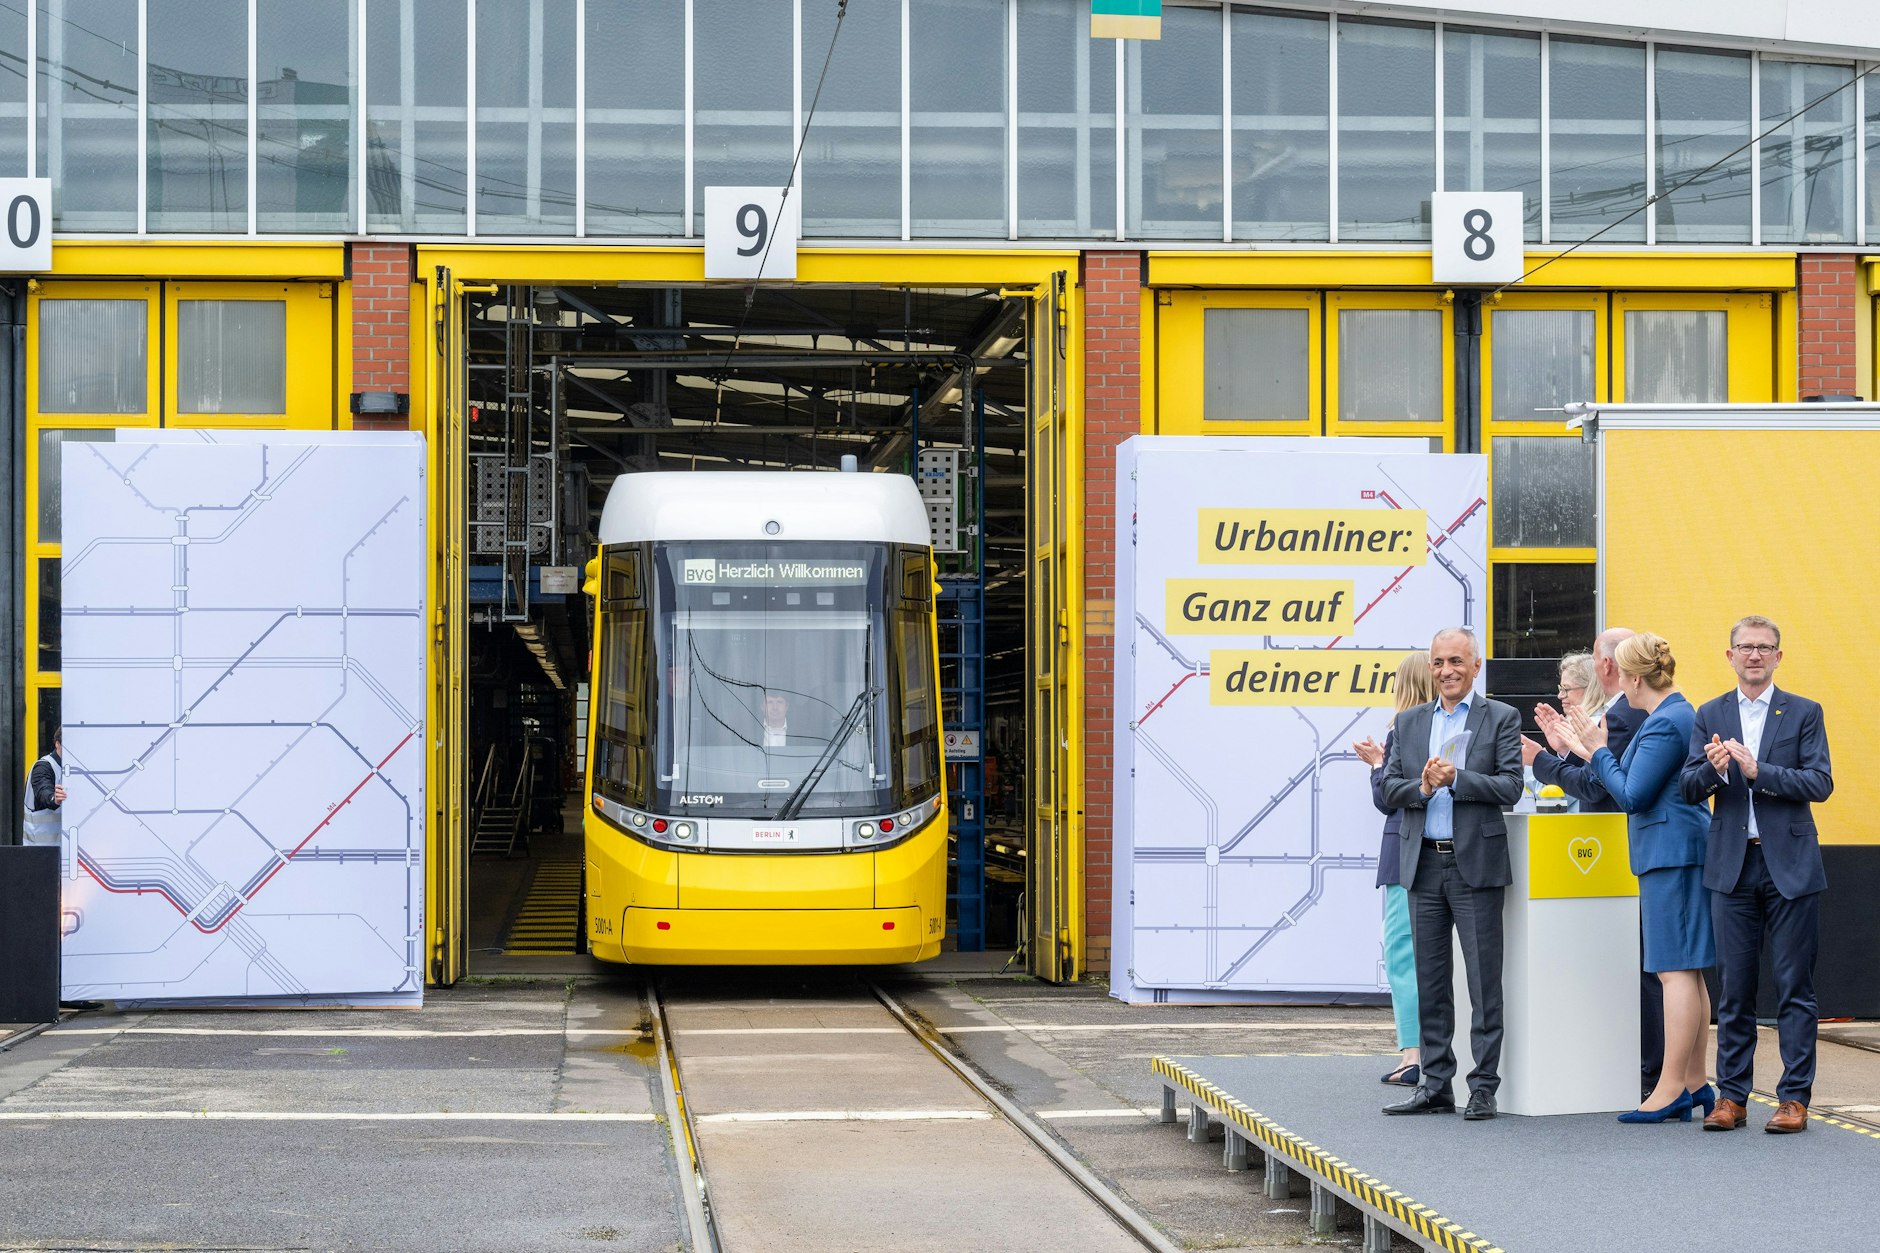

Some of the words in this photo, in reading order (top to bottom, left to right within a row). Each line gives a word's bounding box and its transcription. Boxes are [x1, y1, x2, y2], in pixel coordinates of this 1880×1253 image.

[736, 204, 768, 257] 9
[1463, 209, 1495, 261] 8
[1215, 520, 1413, 552] Urbanliner:
[686, 569, 714, 581] BVG
[719, 564, 774, 578] Herzlich
[779, 563, 863, 578] Willkommen
[1182, 591, 1271, 622] Ganz
[1281, 590, 1345, 623] auf
[1225, 661, 1340, 693] deiner
[327, 802, 337, 812] M4
[679, 795, 724, 805] ALSTOM
[1577, 848, 1593, 858] BVG
[595, 917, 613, 935] 5001-A
